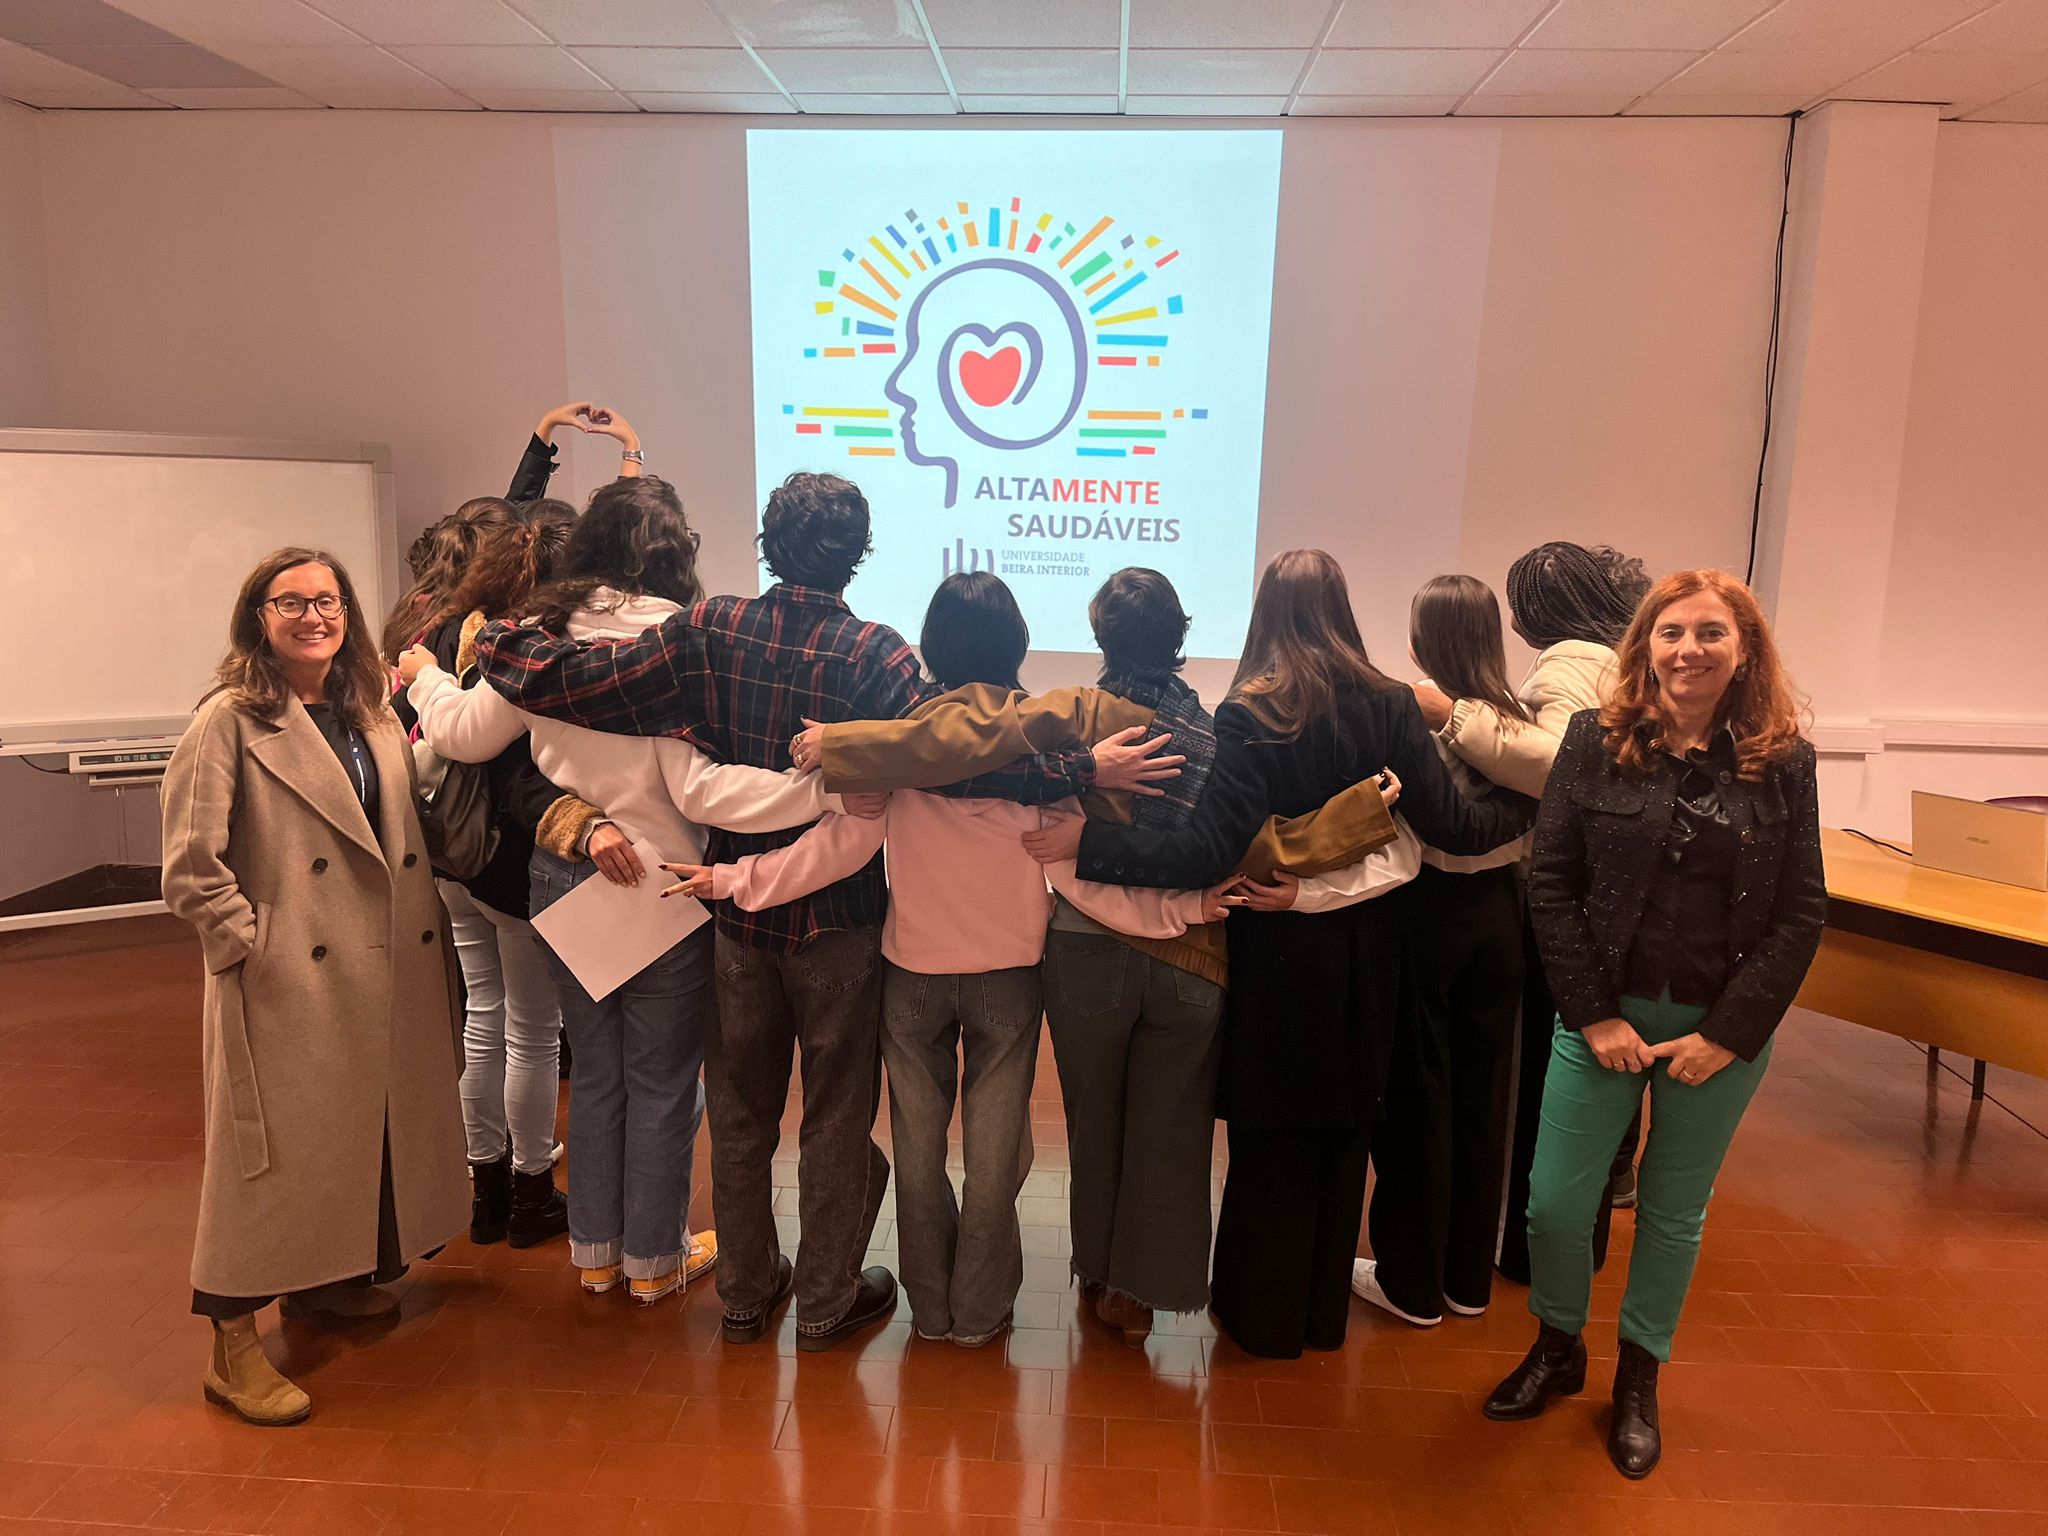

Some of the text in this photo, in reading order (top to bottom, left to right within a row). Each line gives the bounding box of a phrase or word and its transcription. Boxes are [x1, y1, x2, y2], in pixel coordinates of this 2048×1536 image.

[974, 476, 1160, 505] ALTAMENTE
[1007, 510, 1181, 542] SAUDÁVEIS
[1001, 550, 1085, 562] UNIVERSIDADE
[1001, 563, 1090, 576] BEIRA INTERIOR
